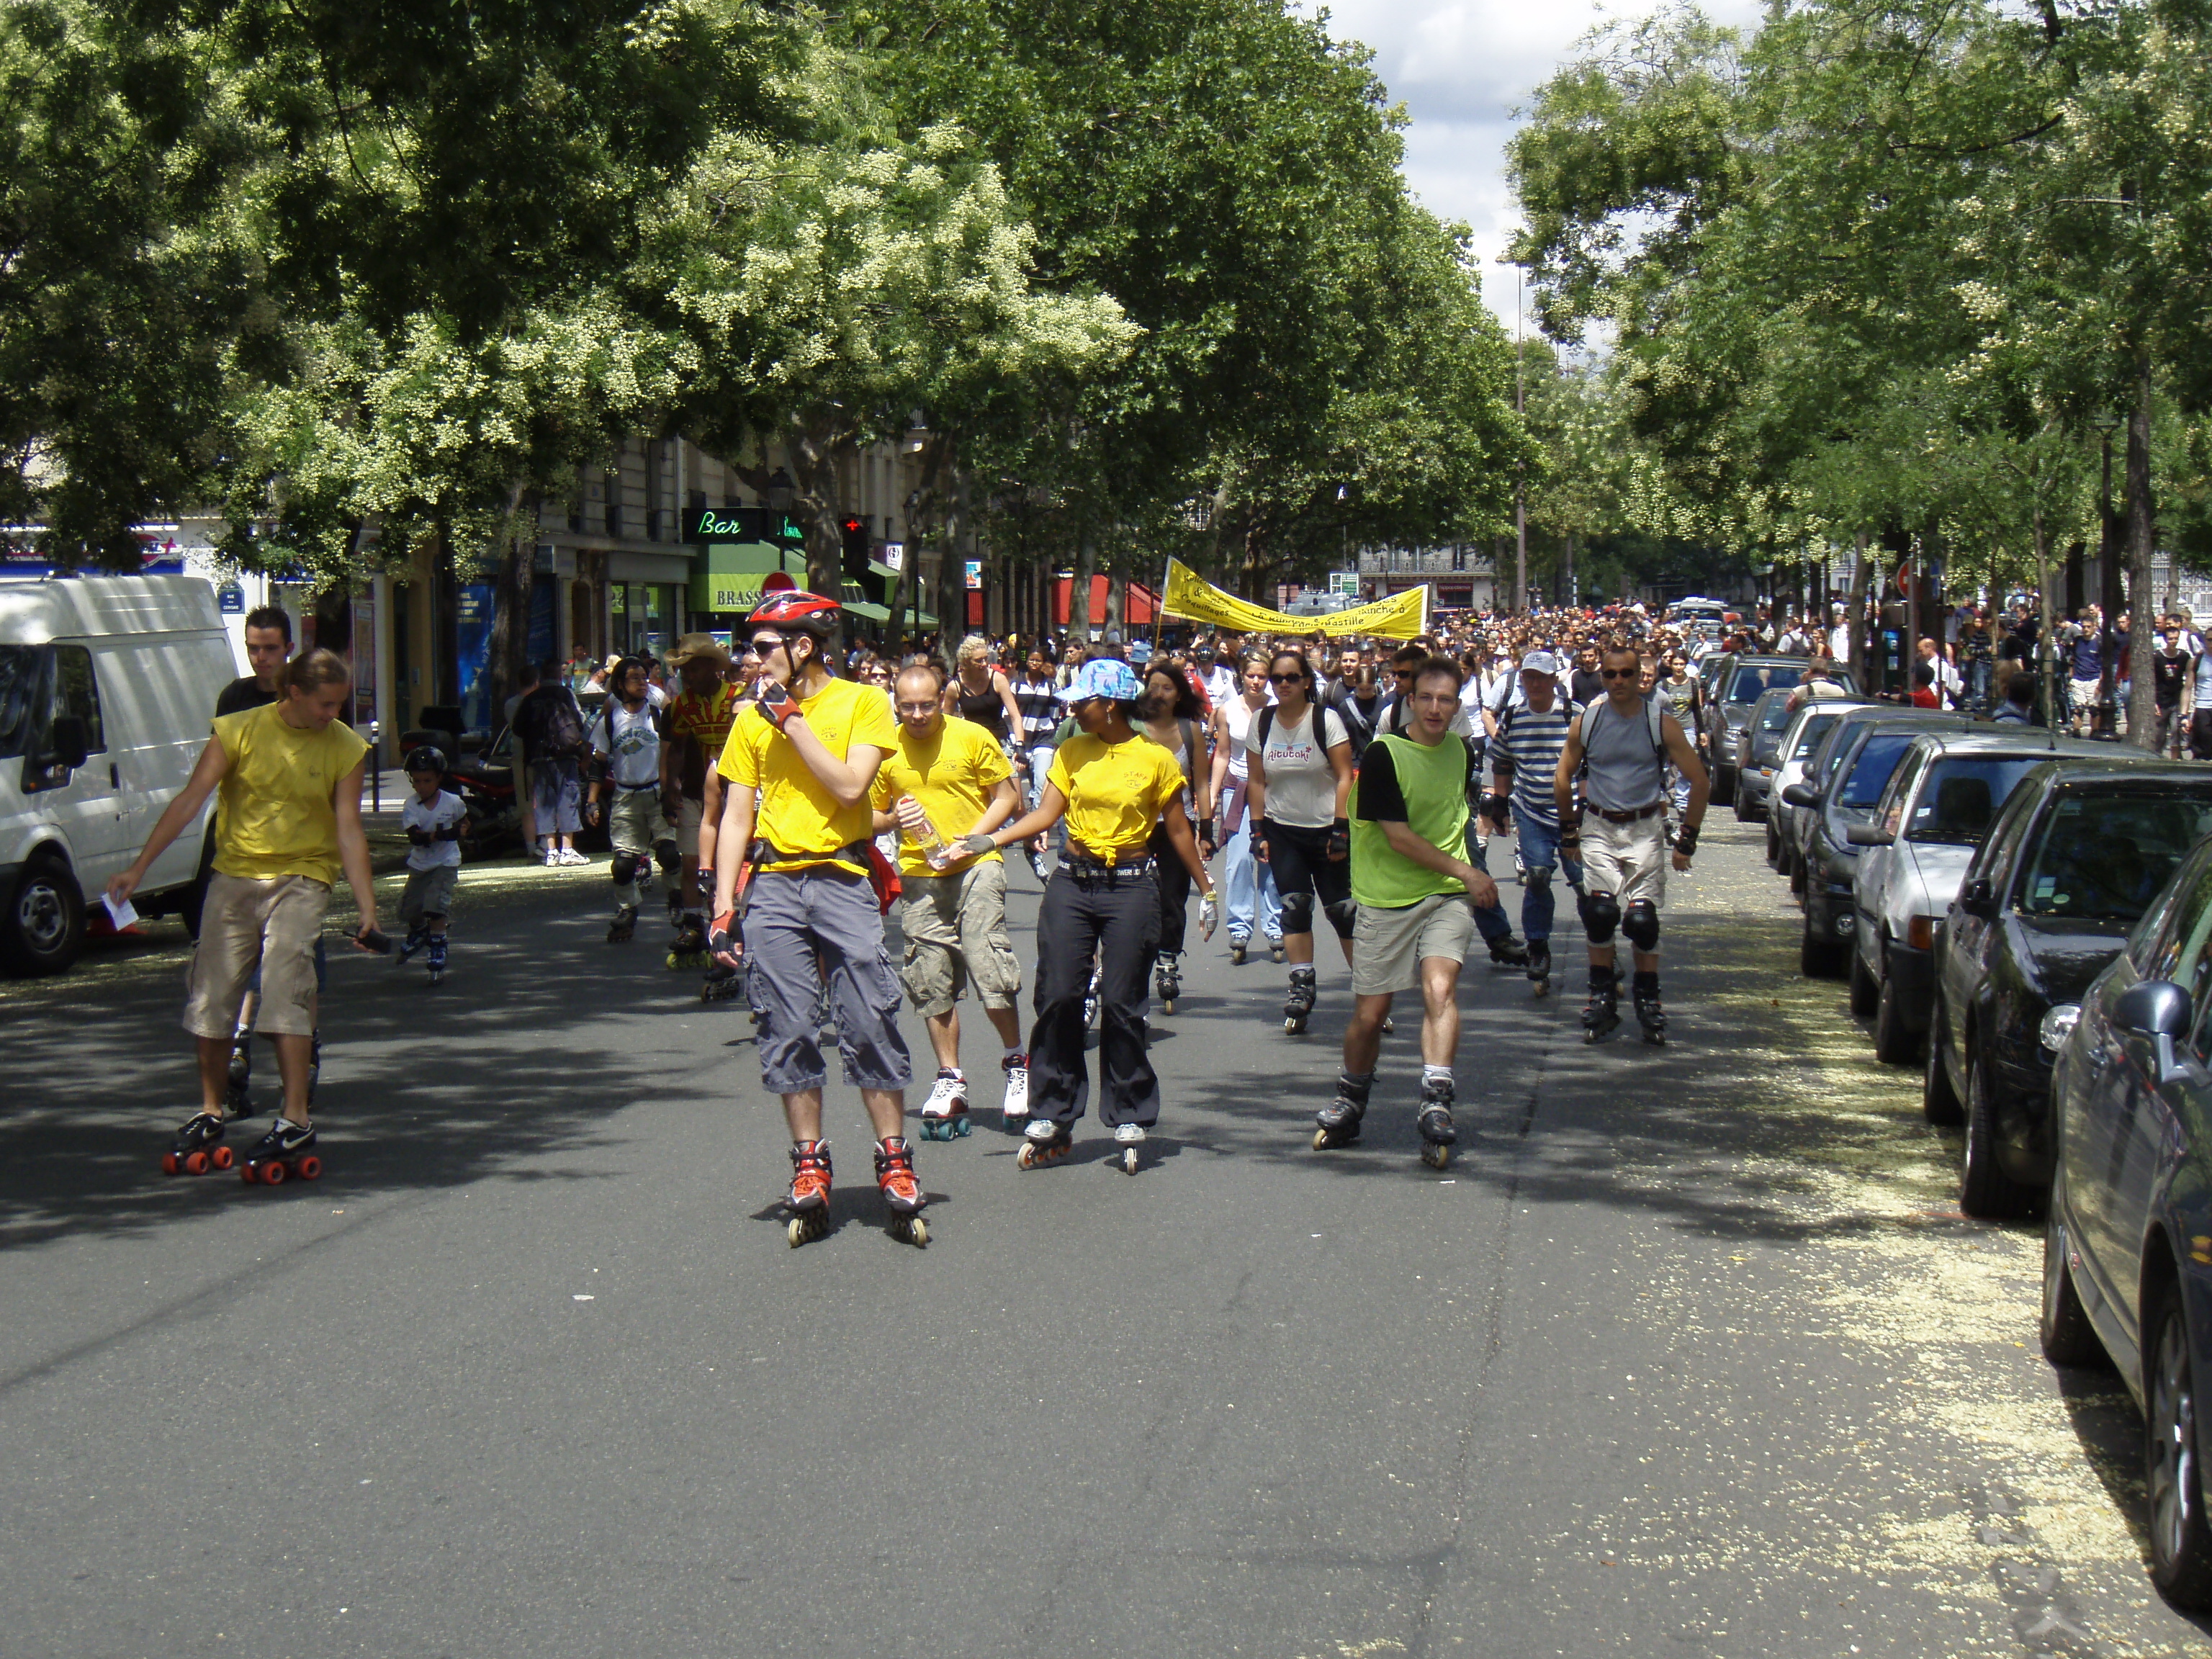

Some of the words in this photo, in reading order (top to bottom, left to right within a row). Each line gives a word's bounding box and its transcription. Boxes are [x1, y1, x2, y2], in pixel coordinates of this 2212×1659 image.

[698, 512, 741, 534] Bar
[1194, 587, 1204, 598] &
[1181, 593, 1230, 617] Coquillages
[1267, 749, 1310, 762] Aitutaki
[1123, 770, 1148, 781] STAFF
